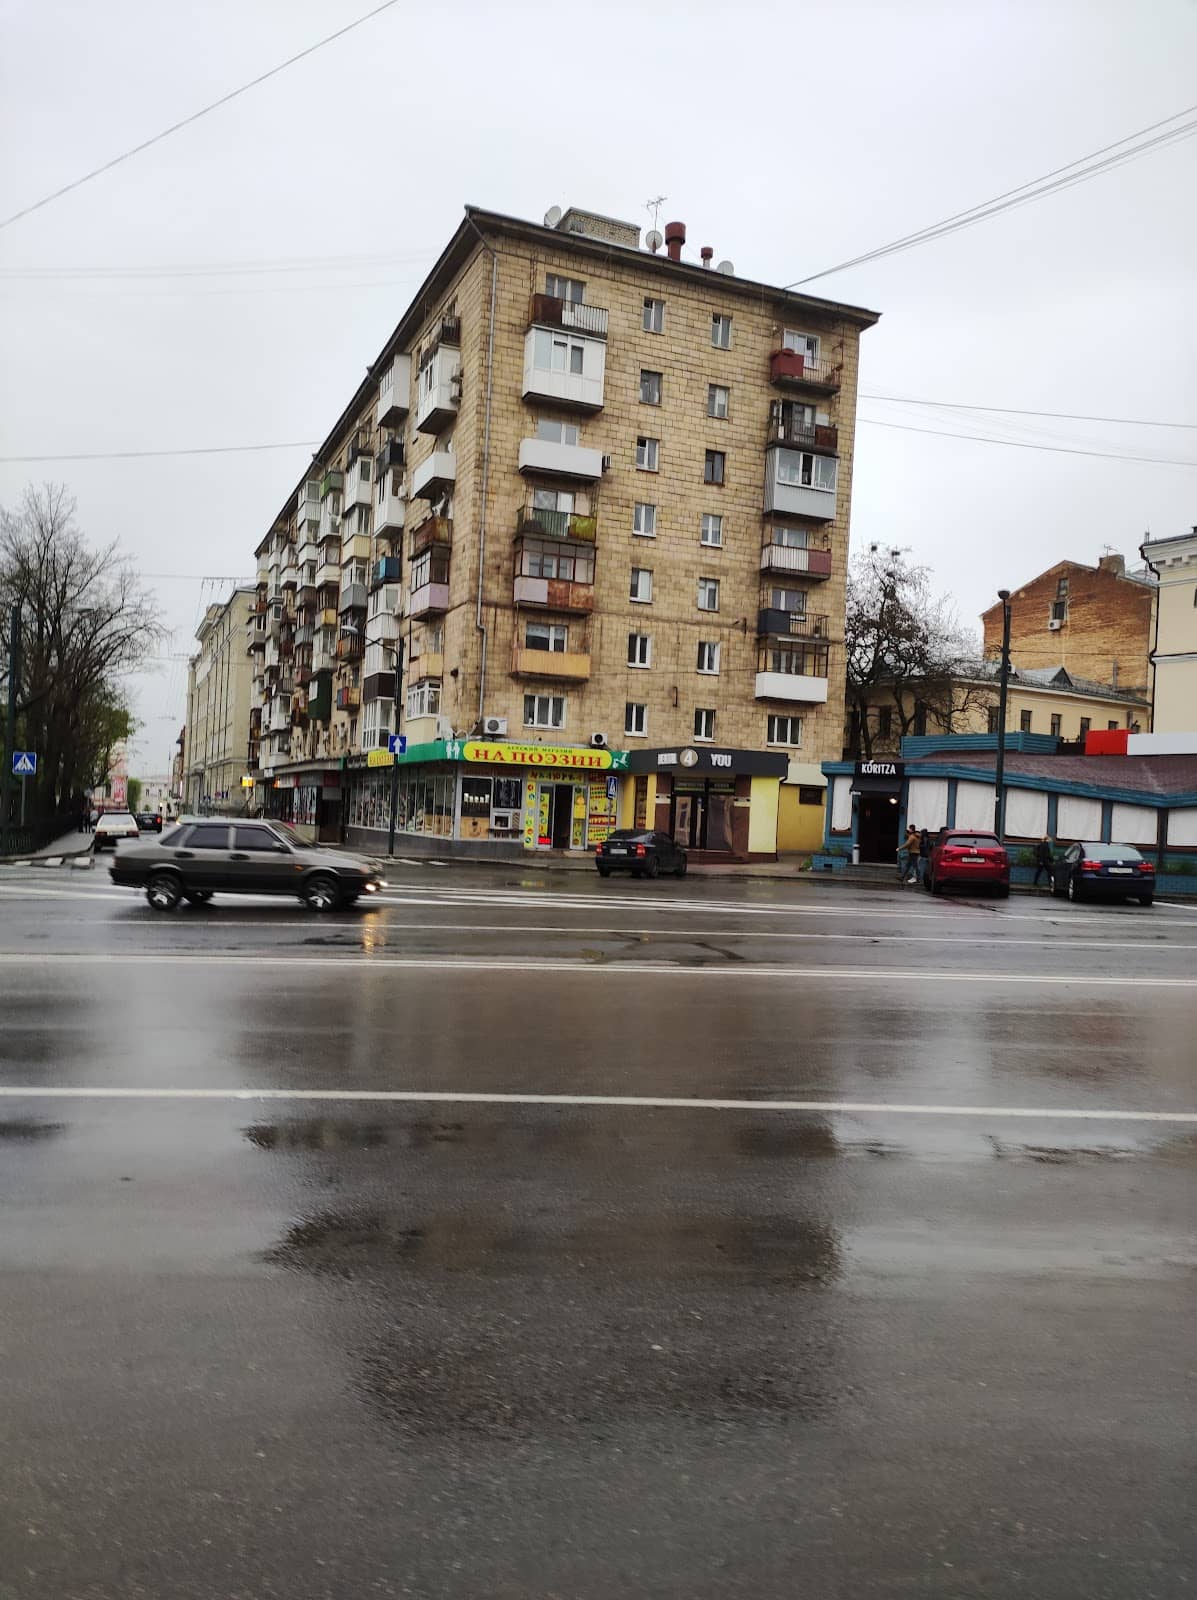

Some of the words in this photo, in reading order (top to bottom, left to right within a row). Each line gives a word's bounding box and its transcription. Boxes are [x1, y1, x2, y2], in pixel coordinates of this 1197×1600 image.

[473, 749, 505, 761] НА
[511, 751, 602, 768] ПОЭЗИИ
[684, 750, 693, 766] 4
[711, 753, 732, 767] YOU
